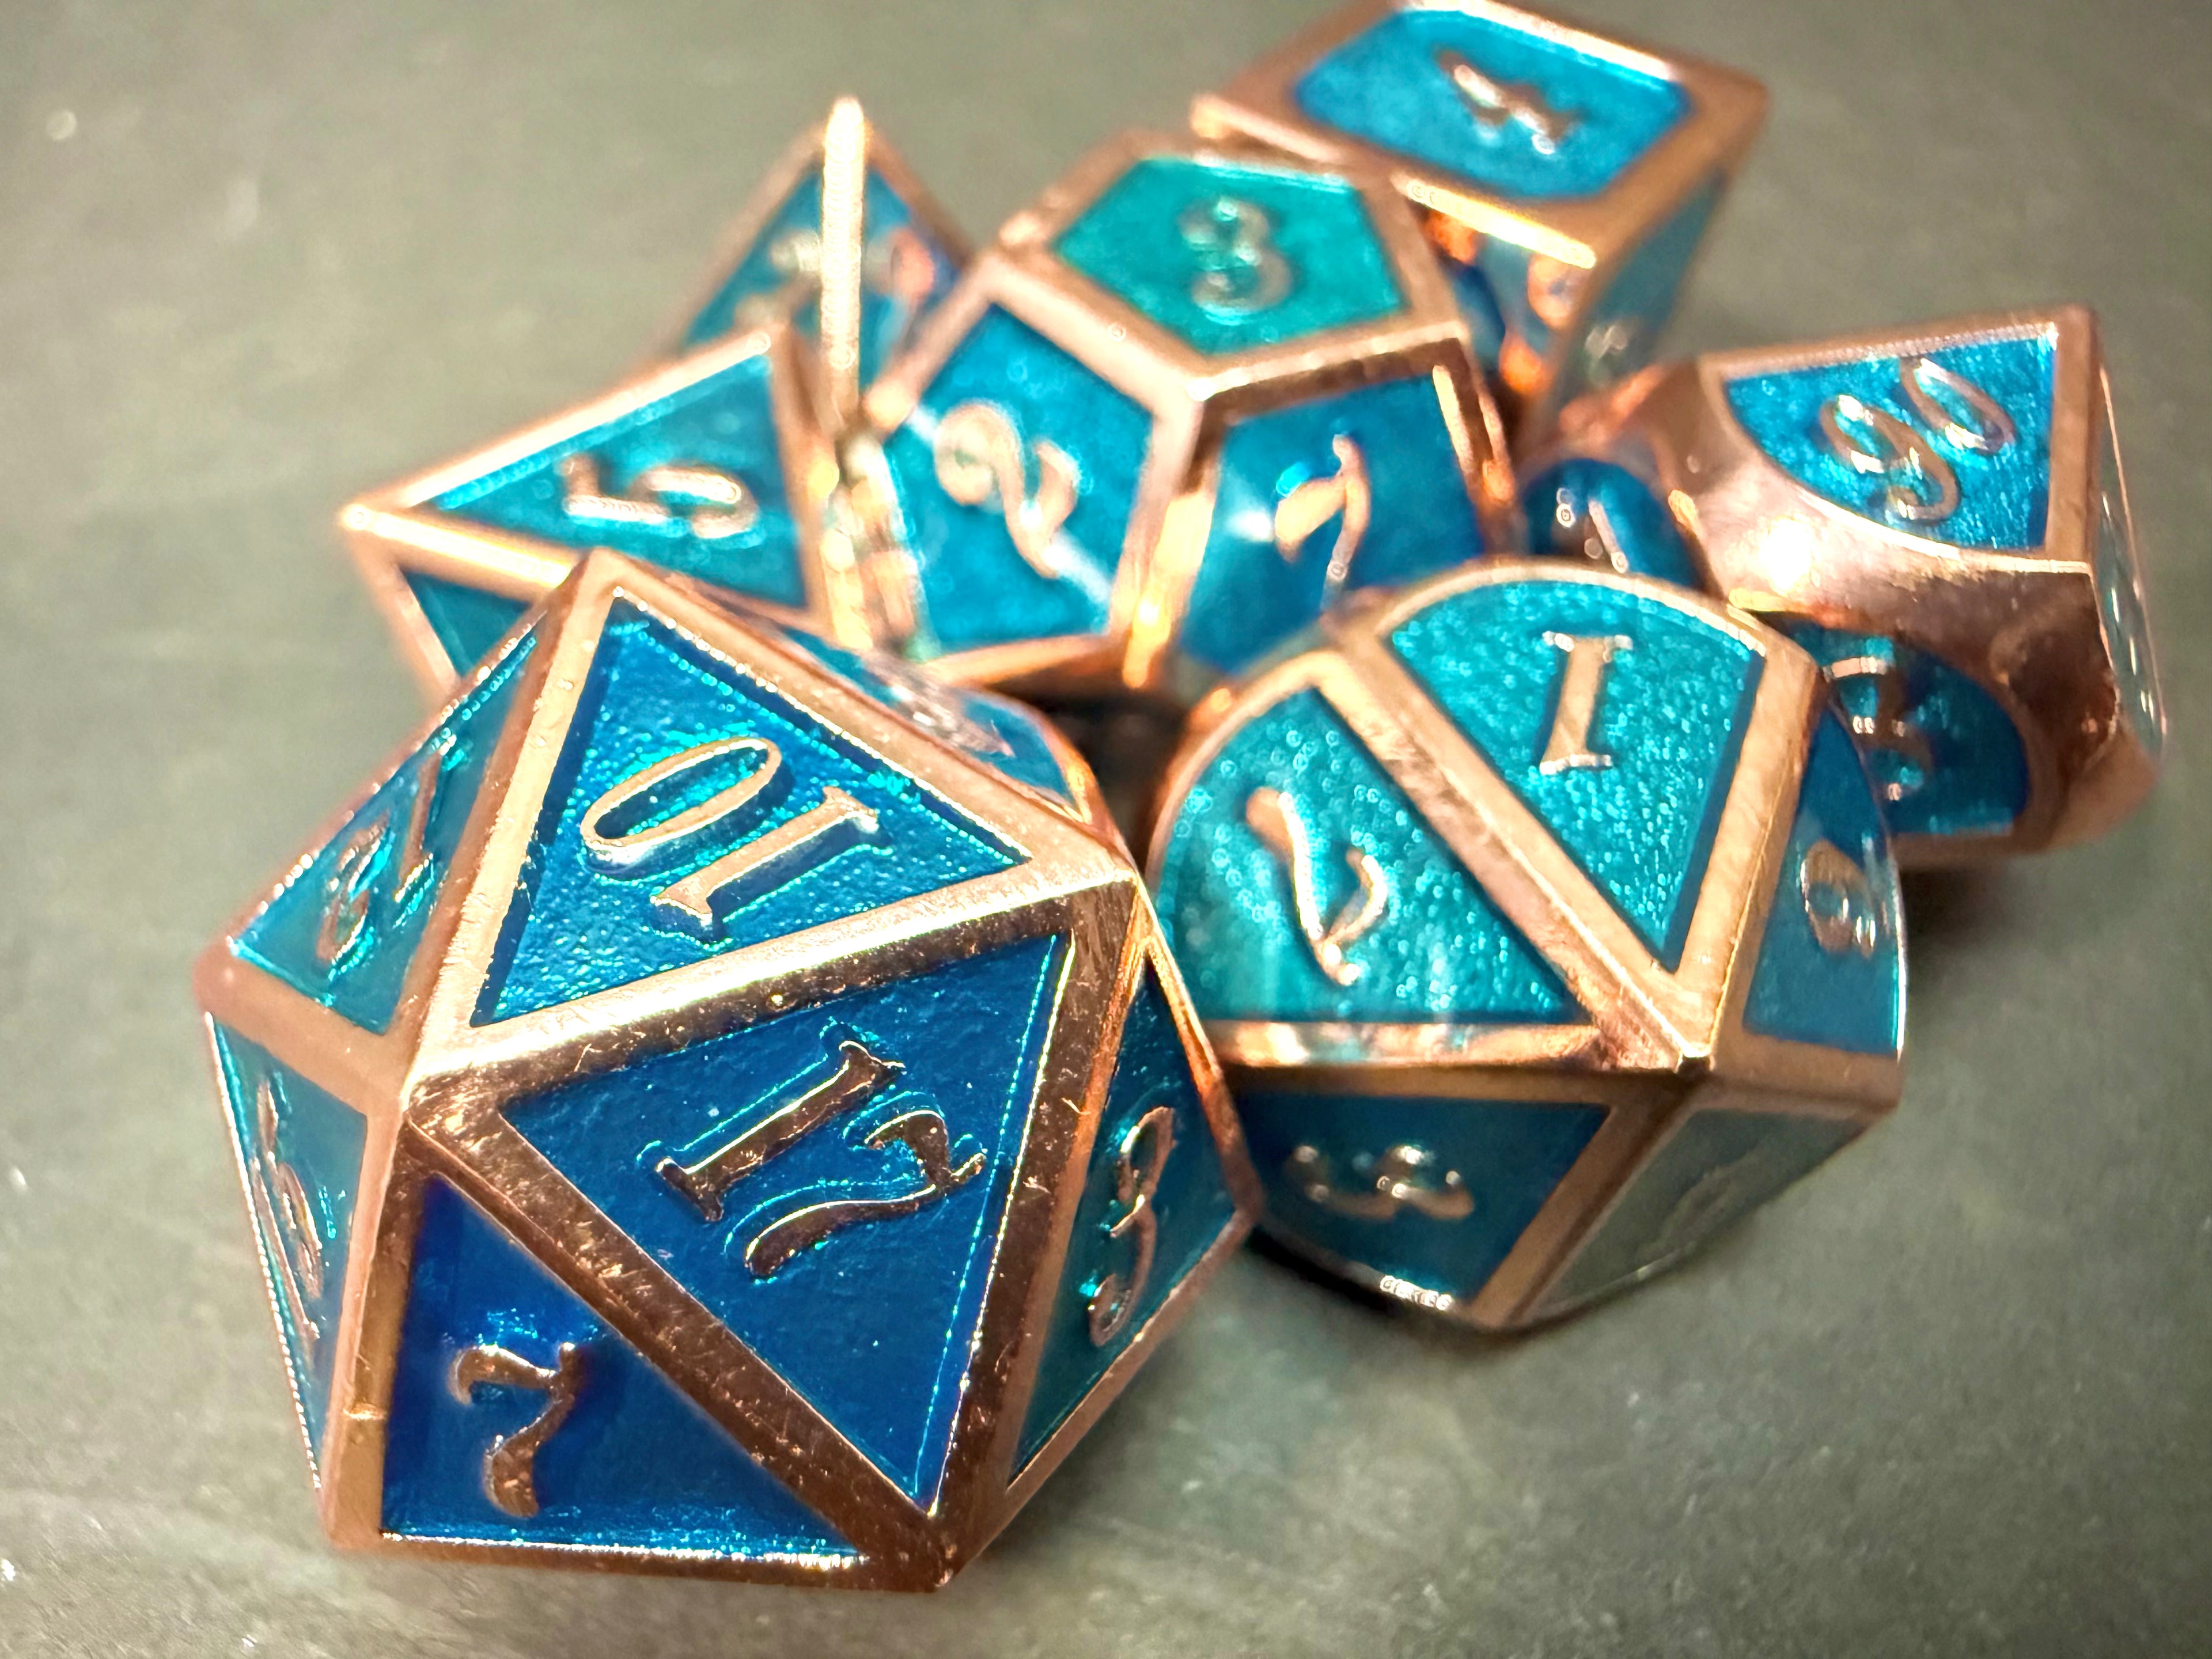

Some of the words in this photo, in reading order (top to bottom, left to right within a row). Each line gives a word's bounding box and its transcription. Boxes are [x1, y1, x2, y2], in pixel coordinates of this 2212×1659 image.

[934, 403, 1080, 579] 2
[1817, 354, 2016, 523] 90
[1541, 628, 1635, 777] 1
[579, 737, 881, 936] 10
[656, 1040, 988, 1279] 17
[1088, 1106, 1176, 1347] 3
[448, 1338, 592, 1520] 7
